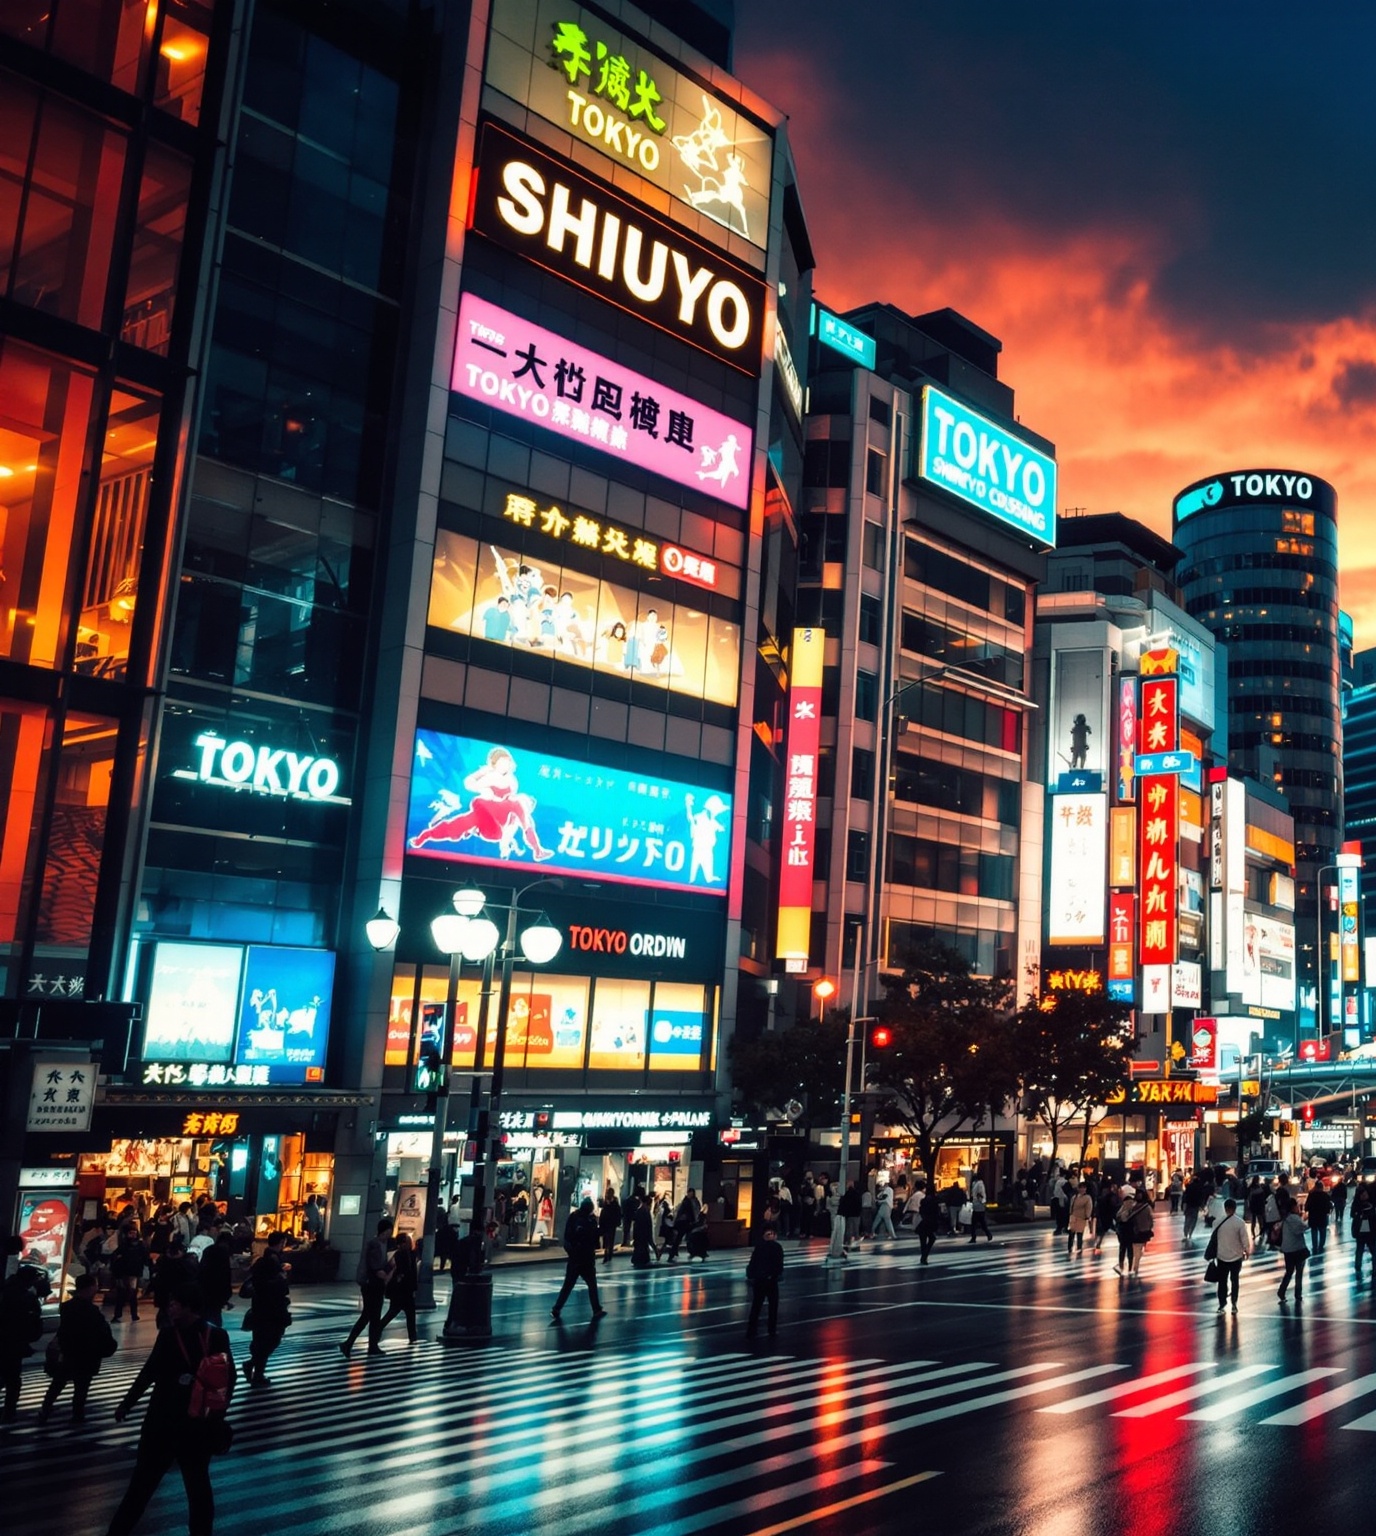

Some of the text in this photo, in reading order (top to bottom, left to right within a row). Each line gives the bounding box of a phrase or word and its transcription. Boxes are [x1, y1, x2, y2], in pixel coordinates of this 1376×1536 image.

[567, 90, 660, 171] TOKYO
[497, 161, 751, 349] SHIUYO
[465, 363, 549, 418] TOKYO
[934, 406, 1046, 507] TOKYO
[1230, 474, 1313, 499] TOKYO
[196, 733, 339, 798] TOKYO
[569, 925, 627, 956] TOKYO
